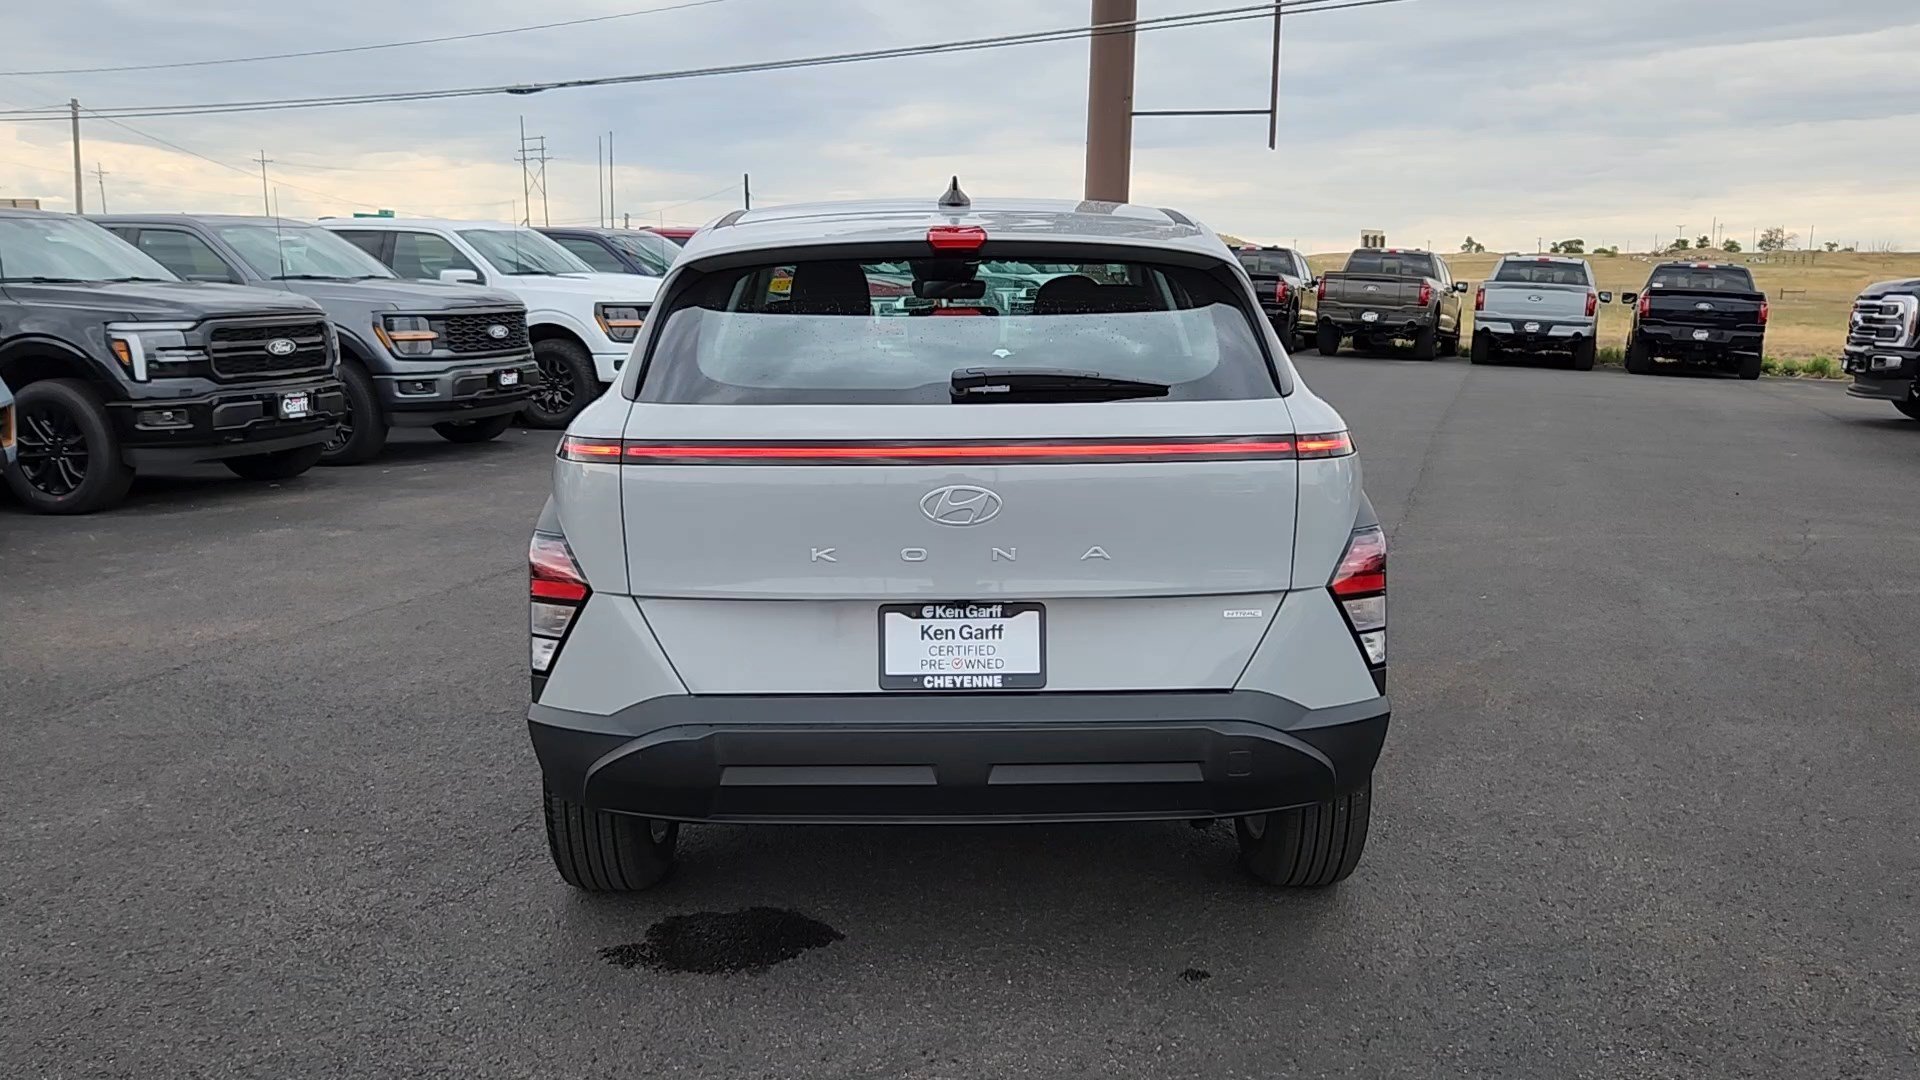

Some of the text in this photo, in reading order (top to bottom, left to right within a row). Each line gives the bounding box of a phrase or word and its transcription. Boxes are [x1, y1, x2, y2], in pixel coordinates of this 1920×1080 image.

[810, 545, 1111, 563] KONA
[935, 604, 1003, 619] Ken Garff
[920, 623, 1004, 641] Ken Garff
[928, 645, 996, 657] CERTIFIED
[923, 675, 1003, 689] CHEYENNE
